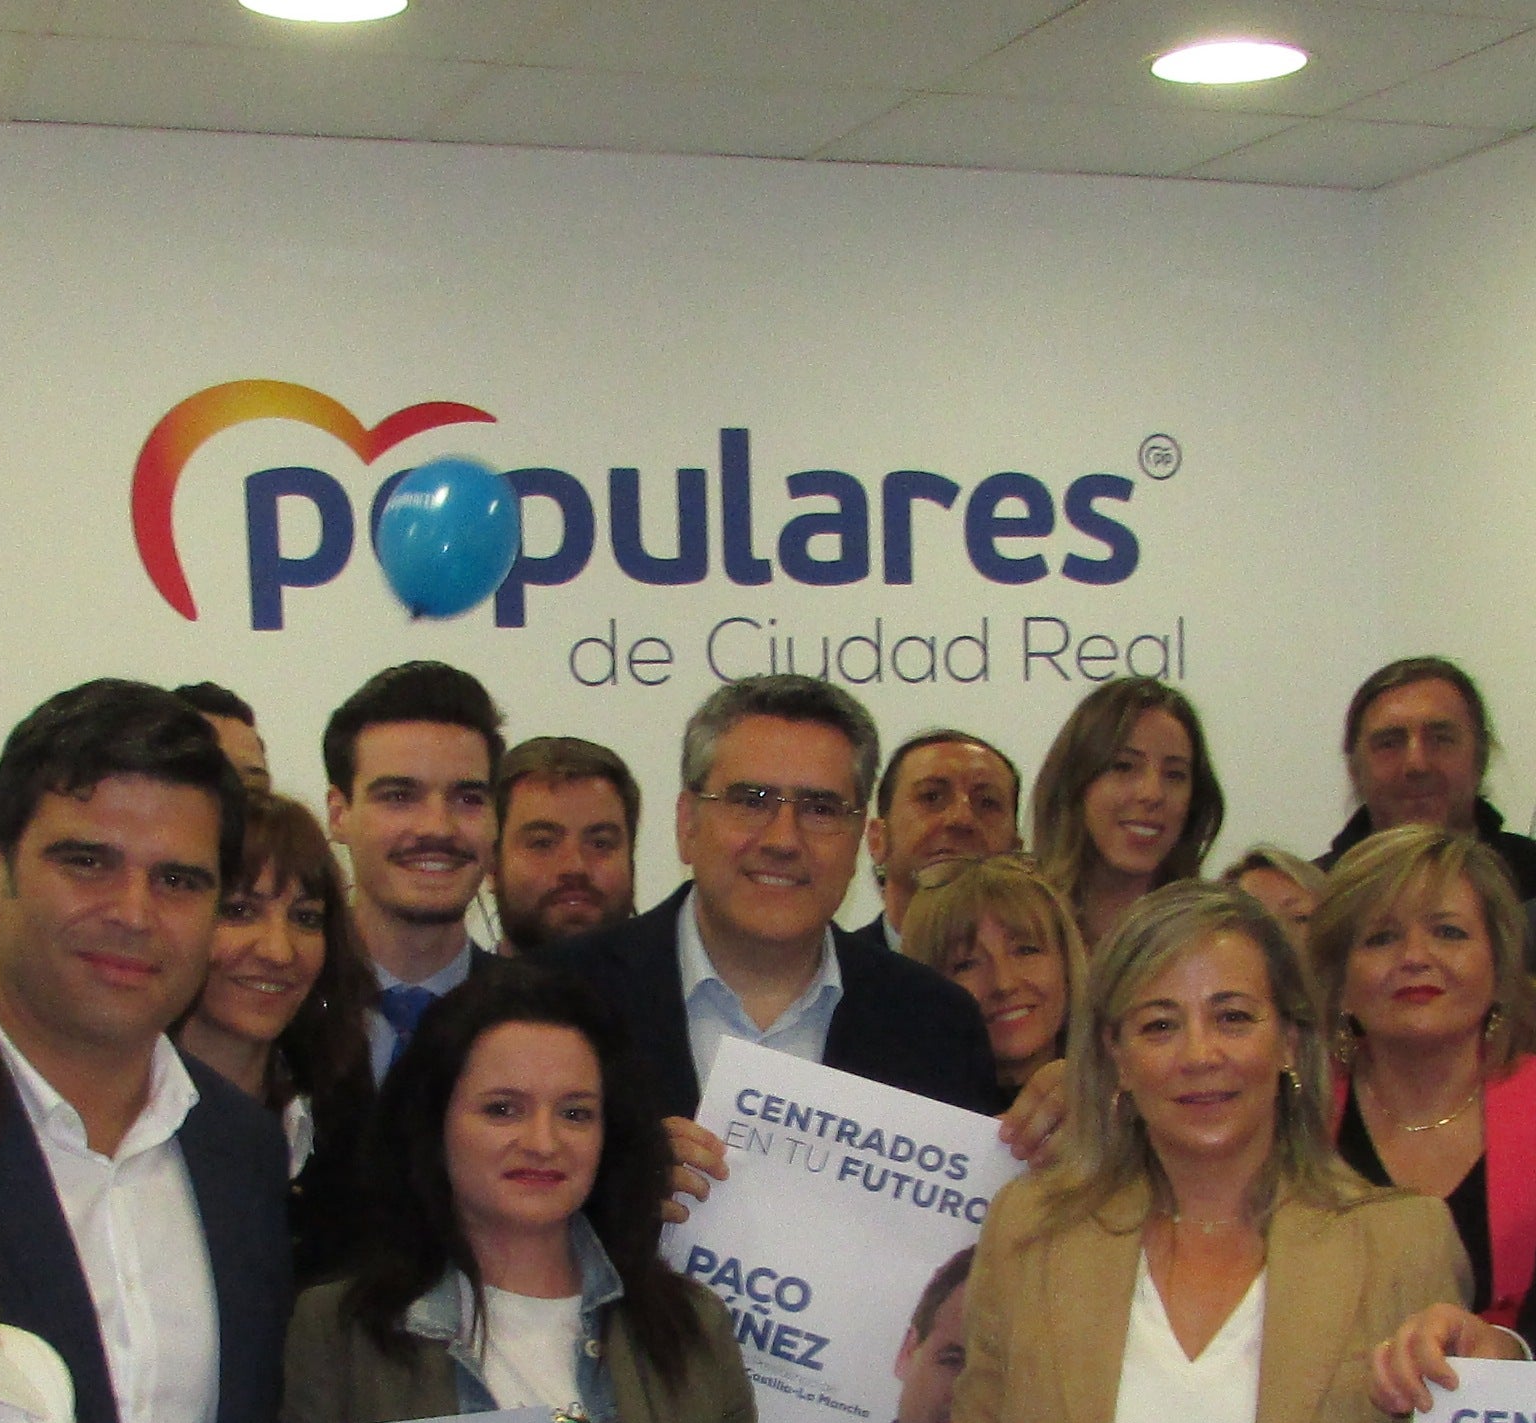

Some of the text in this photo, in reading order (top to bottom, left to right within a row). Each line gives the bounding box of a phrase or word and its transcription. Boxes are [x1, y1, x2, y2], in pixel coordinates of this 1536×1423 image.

[243, 428, 1139, 630] ppulares
[569, 617, 1184, 686] de Ciudad Real
[725, 1121, 773, 1155] EN
[787, 1139, 830, 1173] TU
[736, 1088, 969, 1180] CENTRADOS
[685, 1245, 812, 1312] PACO
